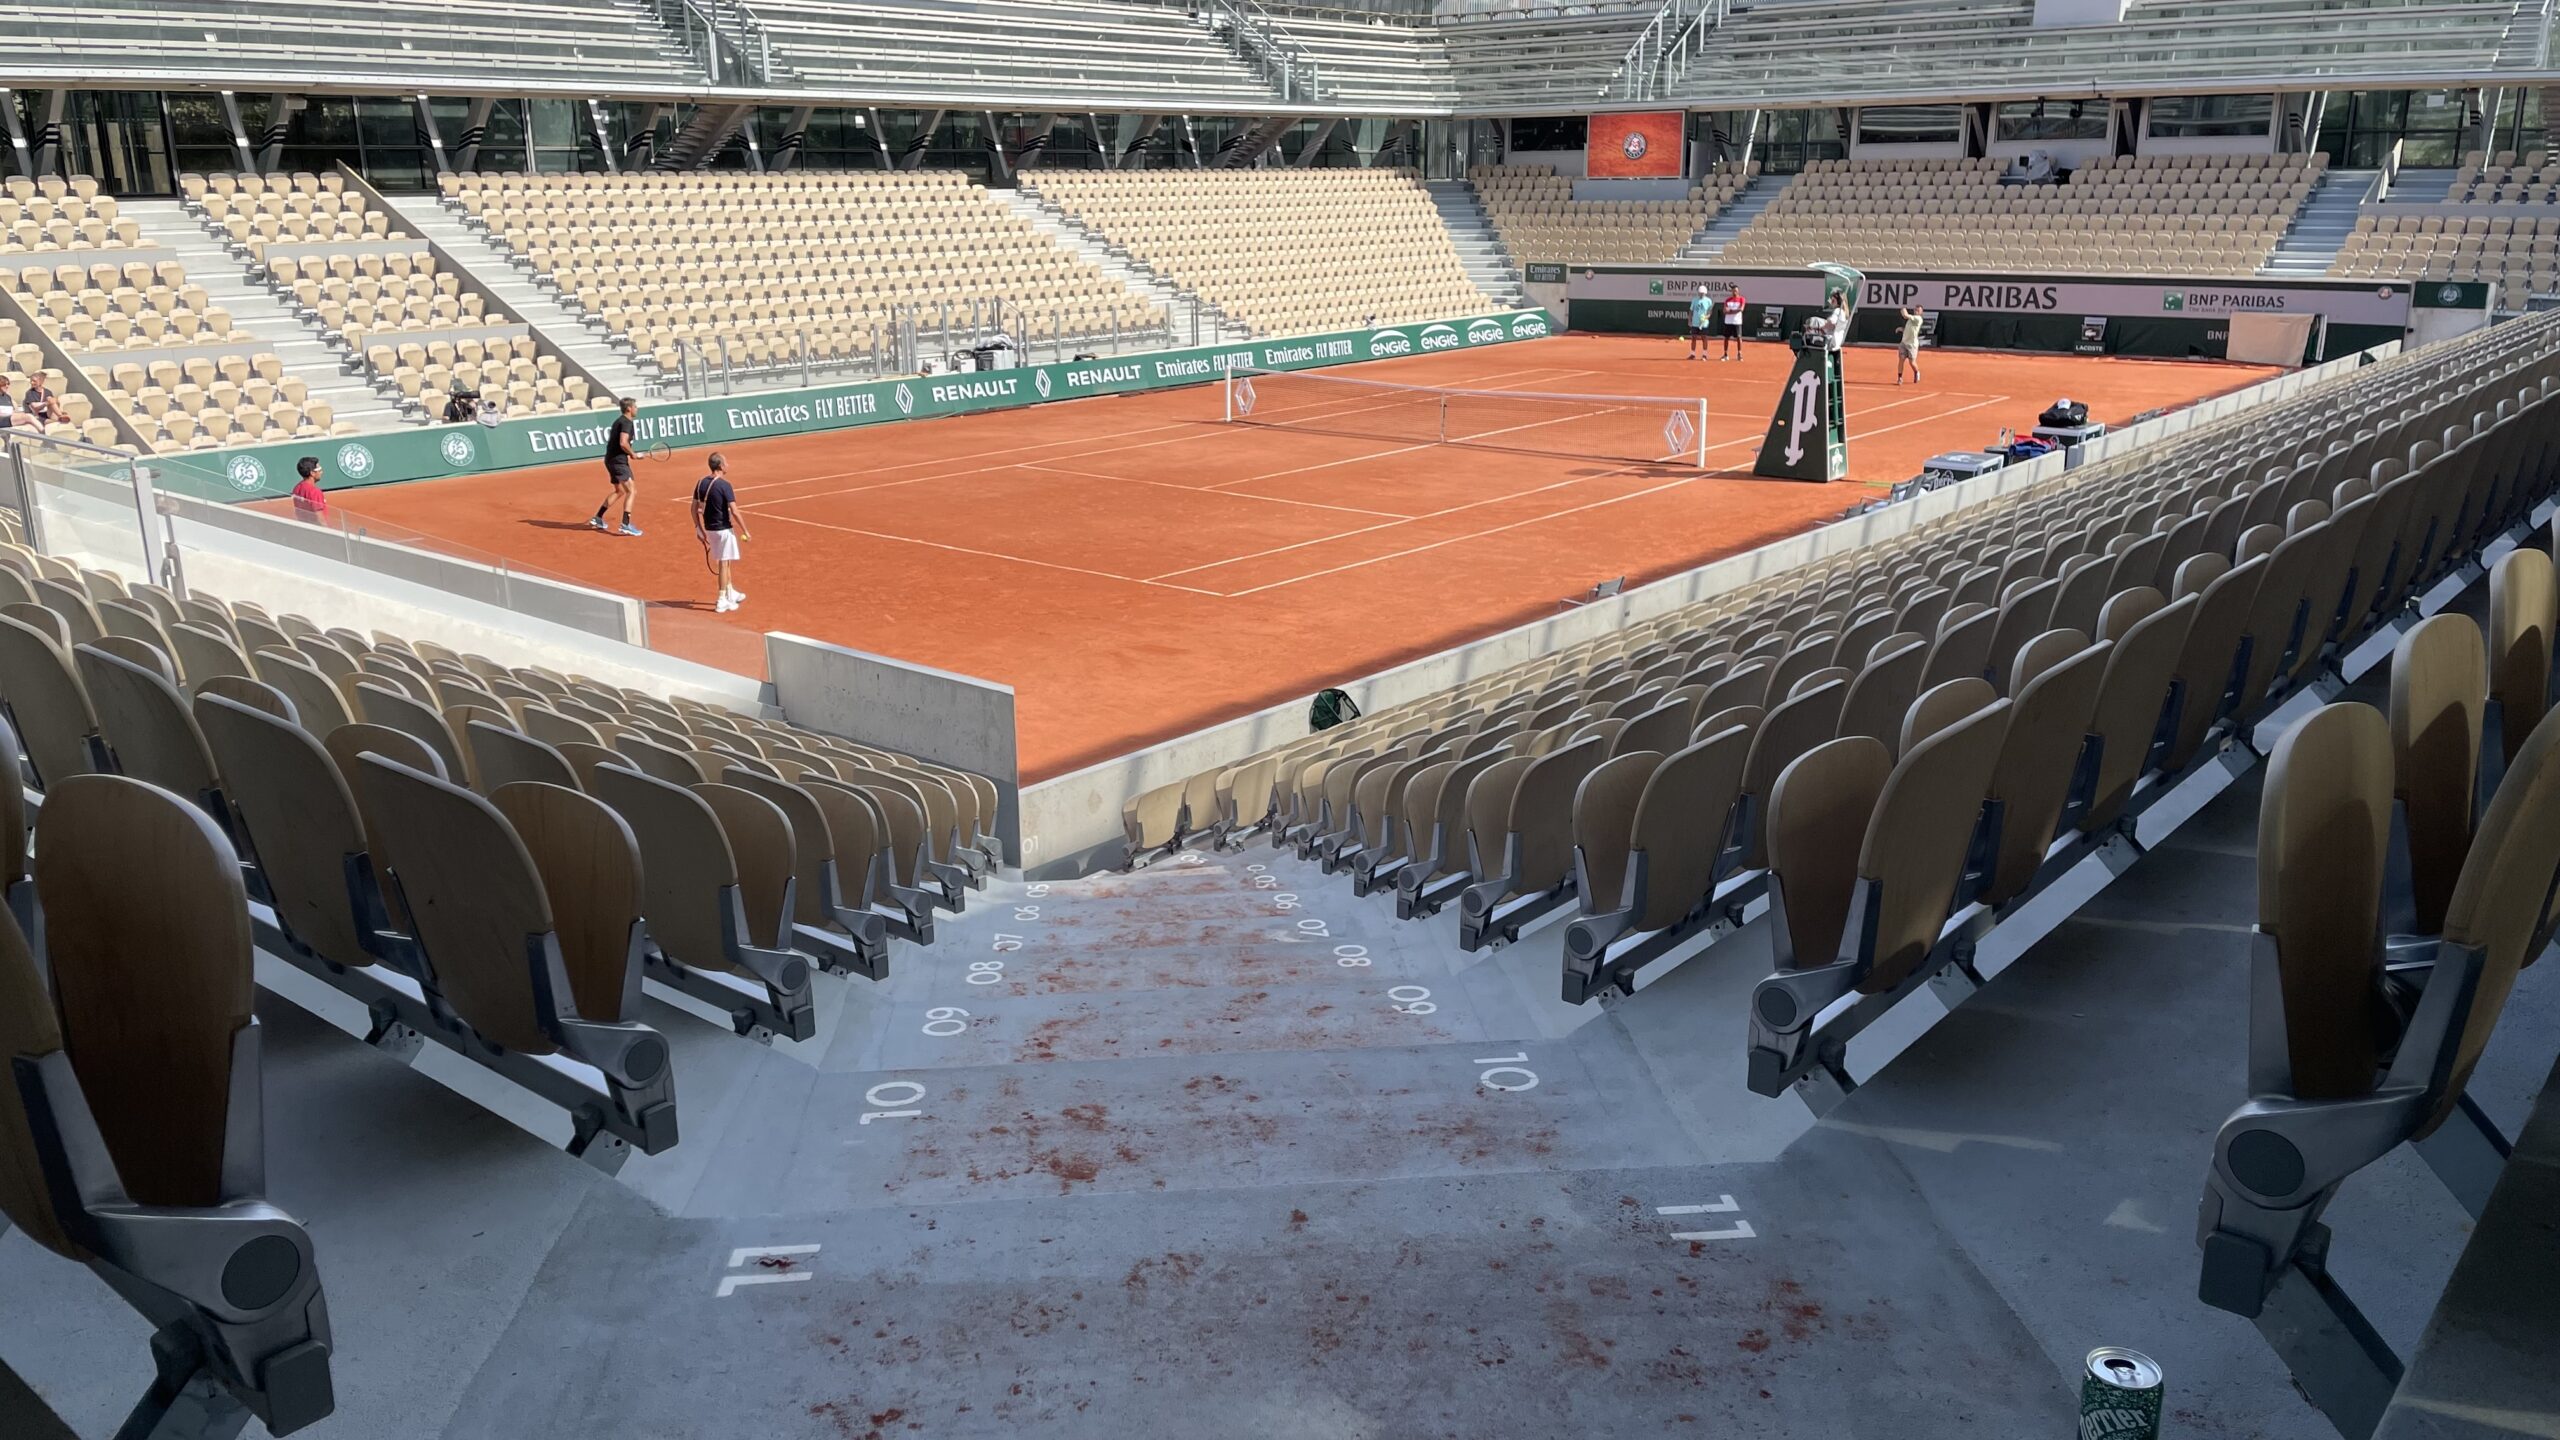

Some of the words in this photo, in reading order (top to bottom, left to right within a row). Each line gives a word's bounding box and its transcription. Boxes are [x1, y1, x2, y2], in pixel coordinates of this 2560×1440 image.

[1667, 280, 1688, 291] BNP
[1867, 283, 1919, 306] BNP
[1944, 284, 2057, 310] PARIBAS
[2189, 293, 2219, 307] BNP
[2222, 295, 2285, 308] PARIBAS
[1647, 310, 1664, 318] BNP
[1665, 311, 1688, 319] PARIB
[1265, 345, 1313, 365] Emirates
[1315, 343, 1328, 359] FLY
[1329, 340, 1353, 357] BETTER
[2075, 344, 2103, 352] LACOSTE
[1066, 364, 1142, 388] RENAULT
[1155, 358, 1210, 379] Emirates
[1213, 355, 1225, 372] FLY
[931, 378, 1018, 403] RENAULT
[727, 401, 809, 430] Emirates
[815, 398, 836, 420] FLY
[836, 393, 876, 418] BETTER
[528, 425, 613, 453] Emirat
[633, 417, 654, 441] FLY
[658, 412, 705, 438] BETTER
[1022, 835, 1039, 854] 01
[1026, 883, 1050, 898] 05
[1273, 893, 1302, 910] 06
[1014, 905, 1040, 921] 06
[1297, 918, 1329, 938] 07
[992, 933, 1024, 951] 07
[1333, 944, 1372, 968] 08
[966, 961, 1004, 985] 08
[1387, 985, 1437, 1016] 09
[922, 1006, 971, 1038] 09
[1473, 1052, 1539, 1091] 10
[860, 1082, 925, 1124] 10
[1656, 1193, 1758, 1242] 11
[715, 1243, 822, 1298] 11
